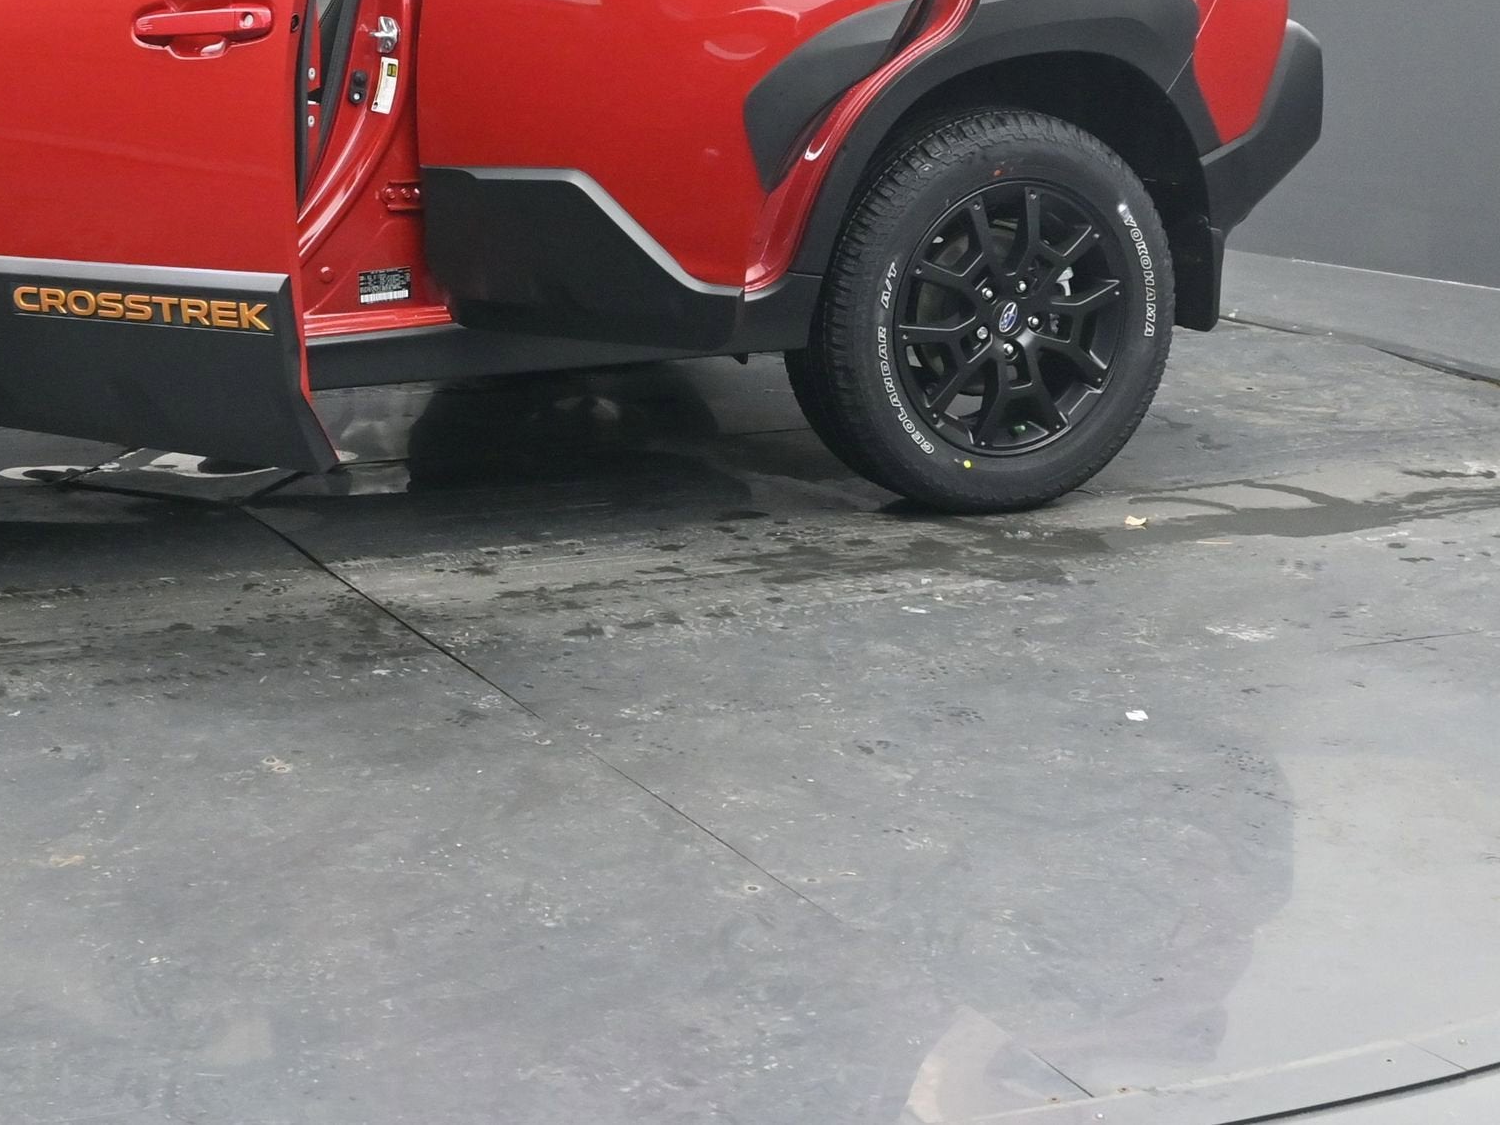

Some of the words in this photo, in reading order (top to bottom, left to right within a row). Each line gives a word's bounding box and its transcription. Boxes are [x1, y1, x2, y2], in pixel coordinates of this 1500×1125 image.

[12, 286, 271, 331] CROSSTREK
[880, 261, 897, 309] A/T
[1123, 215, 1156, 337] YOKOHAMA
[878, 326, 935, 454] GEOLANDAR
